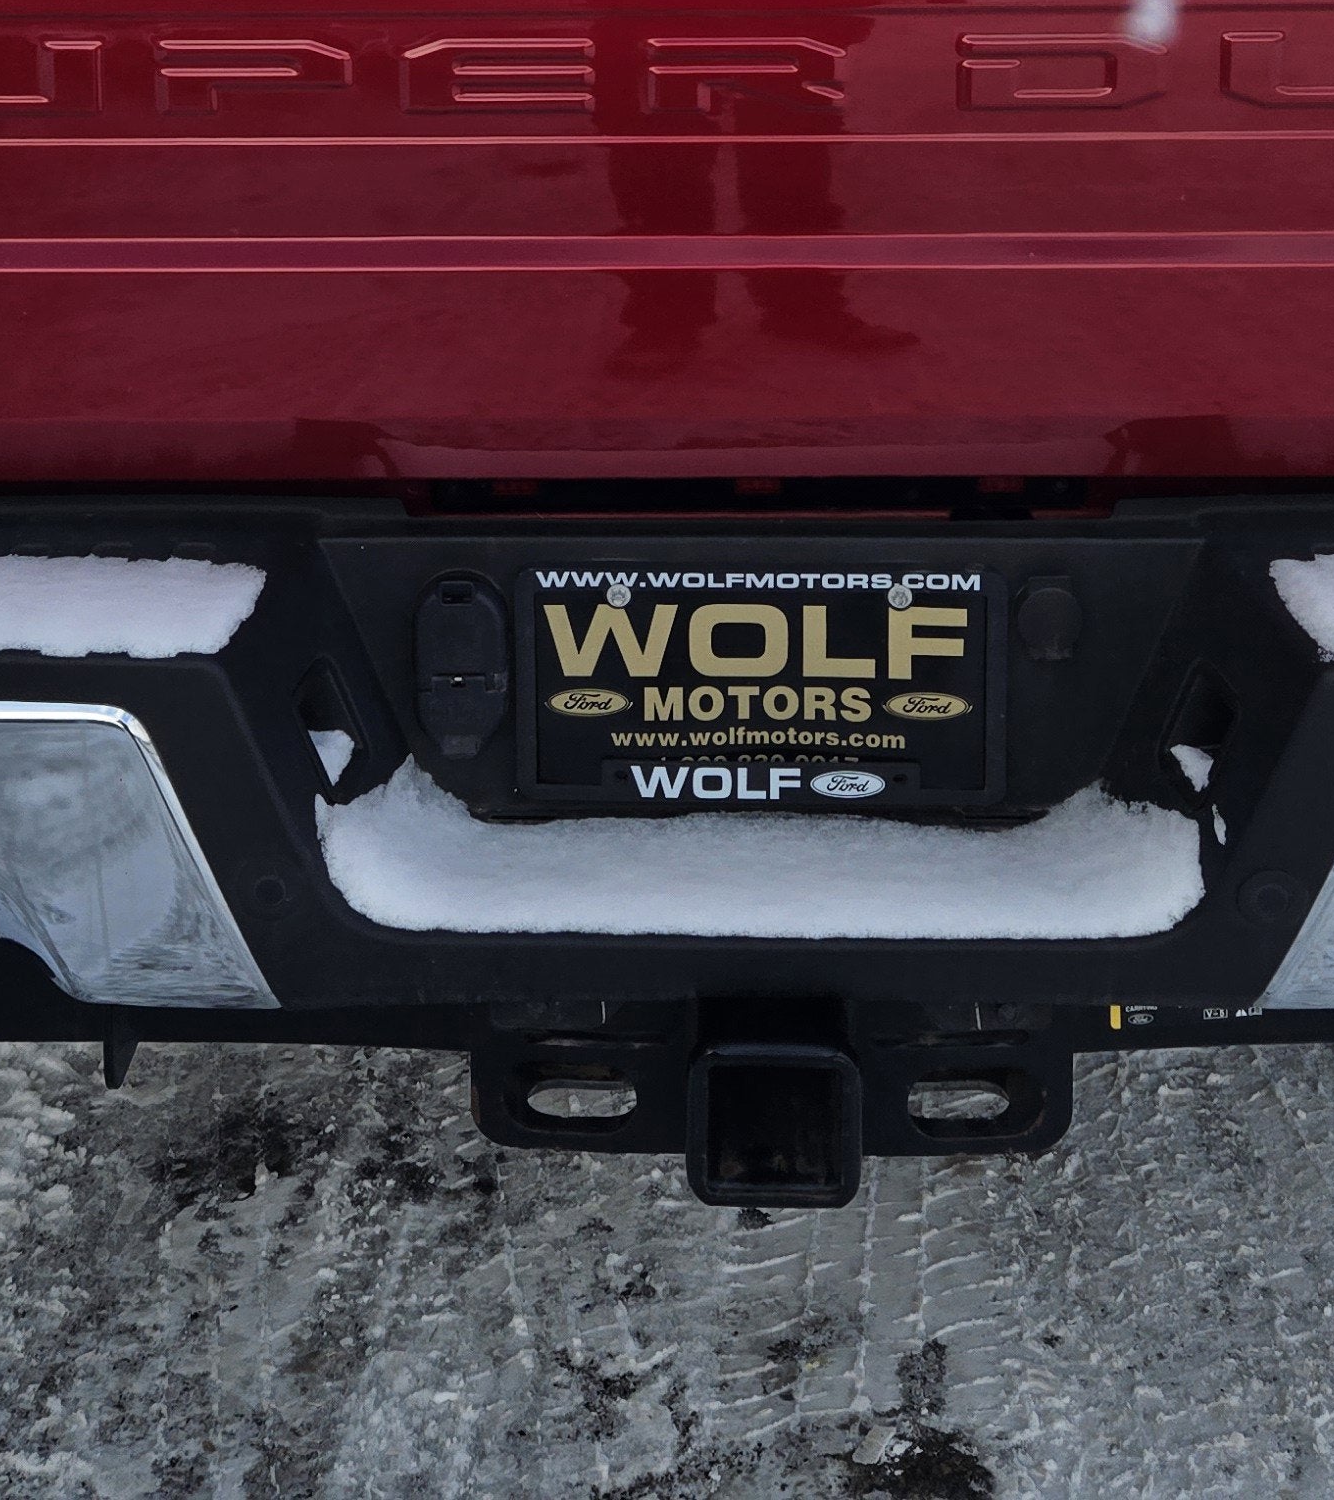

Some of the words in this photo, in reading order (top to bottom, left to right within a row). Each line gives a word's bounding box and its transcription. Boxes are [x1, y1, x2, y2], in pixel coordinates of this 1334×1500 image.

[543, 604, 968, 680] WOLF
[563, 690, 613, 711] Ford
[643, 686, 873, 722] MOTORS
[902, 694, 952, 715] Ford
[610, 727, 906, 750] www.wolfmotors.com
[630, 765, 802, 800] WOLF
[826, 771, 870, 793] Ford
